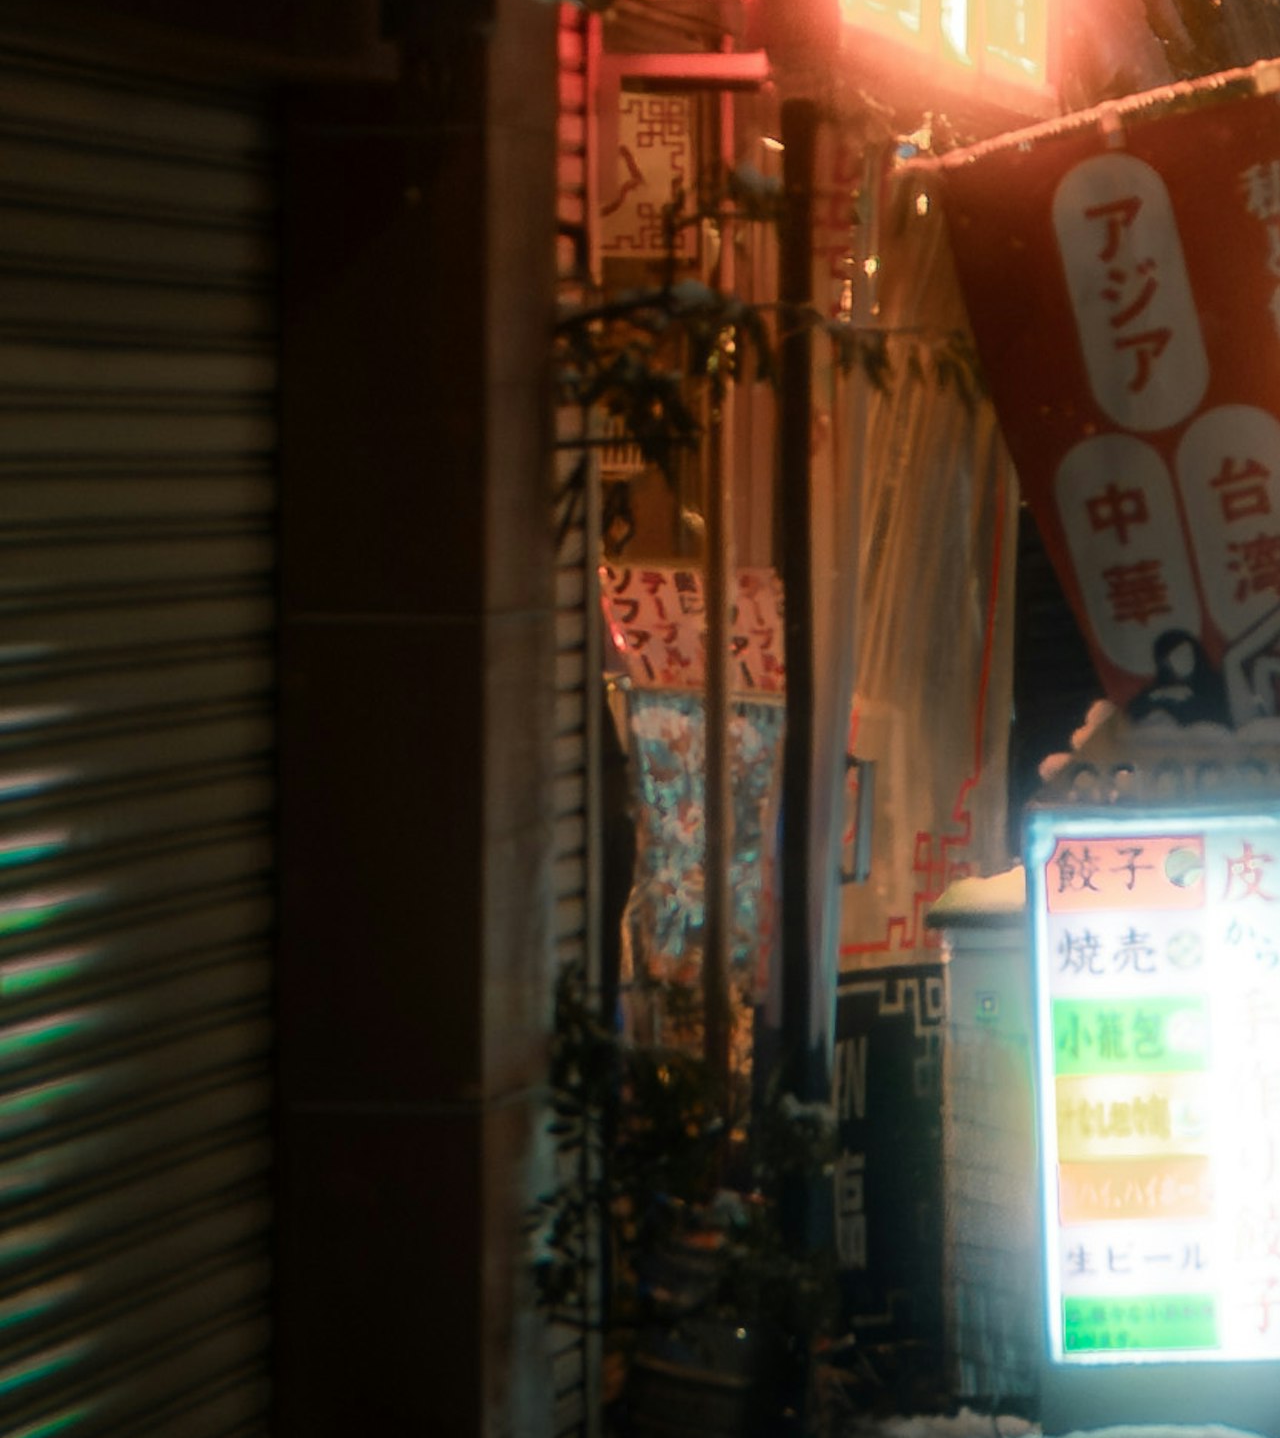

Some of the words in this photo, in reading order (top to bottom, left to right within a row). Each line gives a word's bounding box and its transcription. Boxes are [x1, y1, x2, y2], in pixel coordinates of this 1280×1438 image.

[1083, 195, 1172, 393] アジア
[1086, 483, 1172, 627] 中華
[1055, 845, 1154, 895] 餃子
[1056, 928, 1158, 976] 焼売
[1058, 1011, 1165, 1061] 小籠包
[1065, 1242, 1209, 1278] 生ビール
